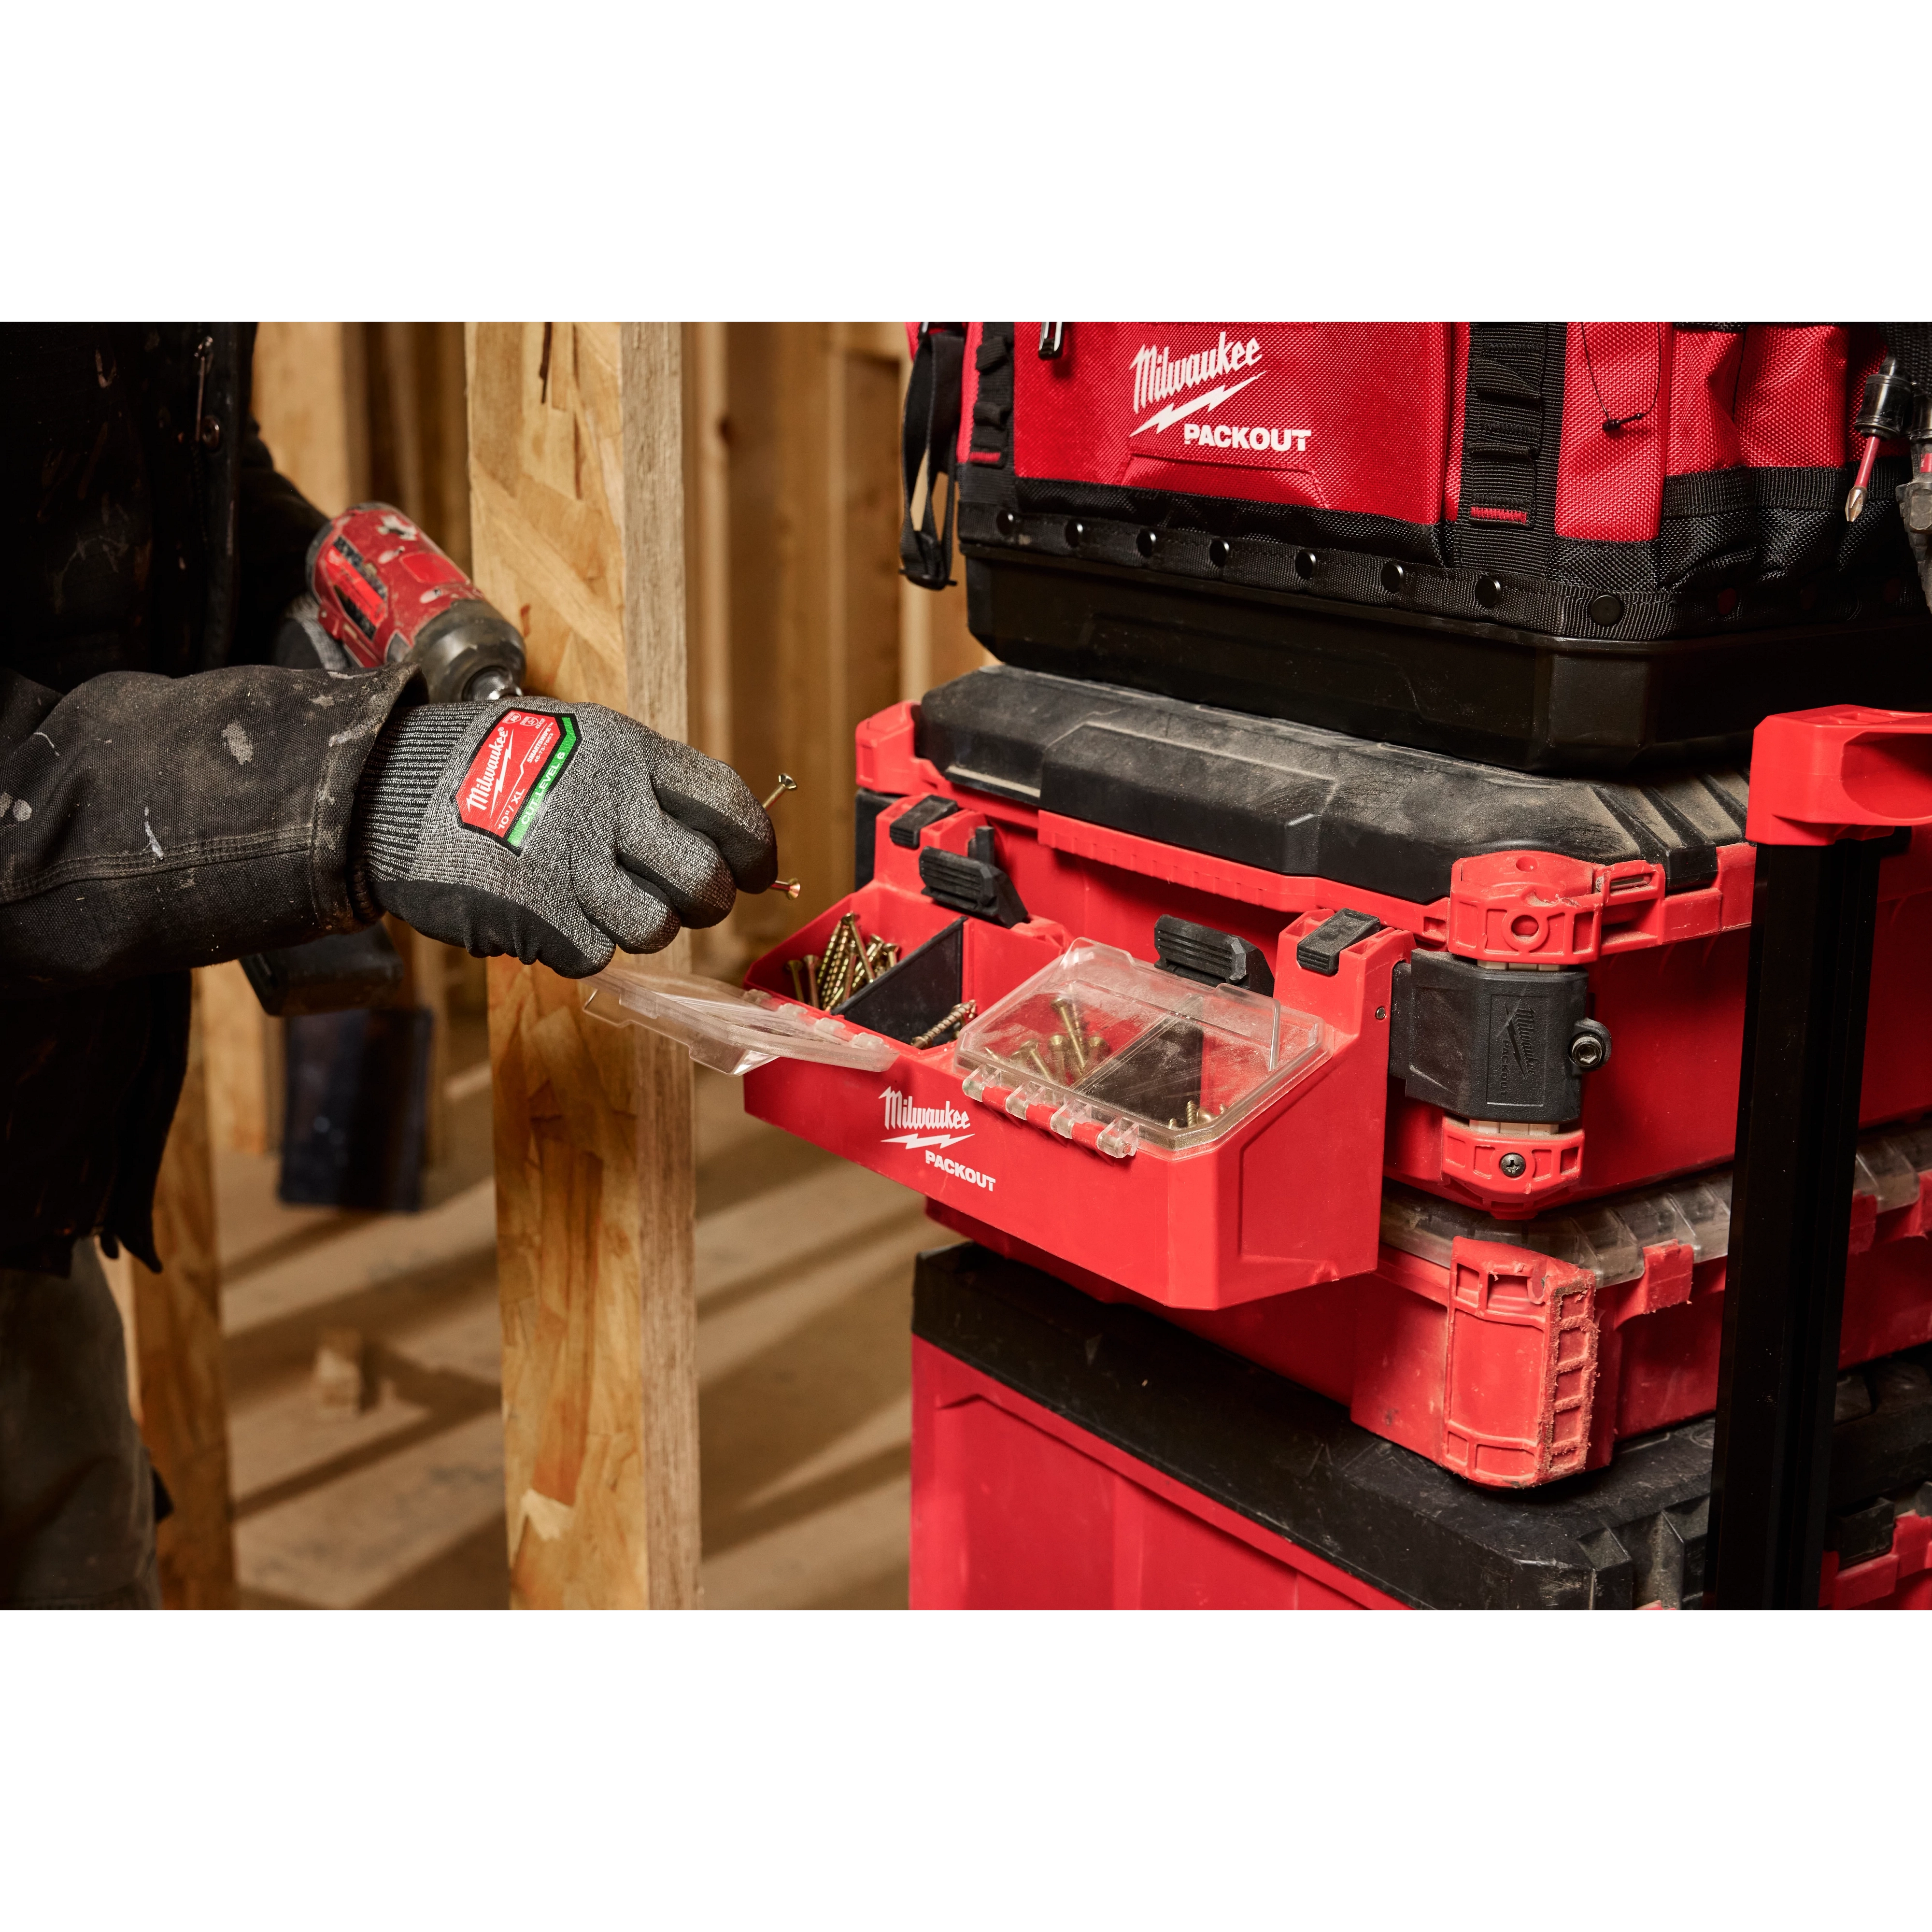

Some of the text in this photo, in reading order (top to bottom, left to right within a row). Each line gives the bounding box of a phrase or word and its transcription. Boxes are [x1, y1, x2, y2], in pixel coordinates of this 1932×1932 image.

[1129, 331, 1262, 414] Milwaukee
[1184, 423, 1311, 451] PACKOUT
[534, 733, 554, 763] 48-73-7003
[511, 788, 525, 804] XL
[521, 799, 539, 825] CUT
[535, 763, 560, 797] LEVEL
[1514, 1004, 1539, 1075] Milwaukee
[878, 1086, 971, 1130] Milwaukee
[925, 1150, 996, 1192] PACKOUT
